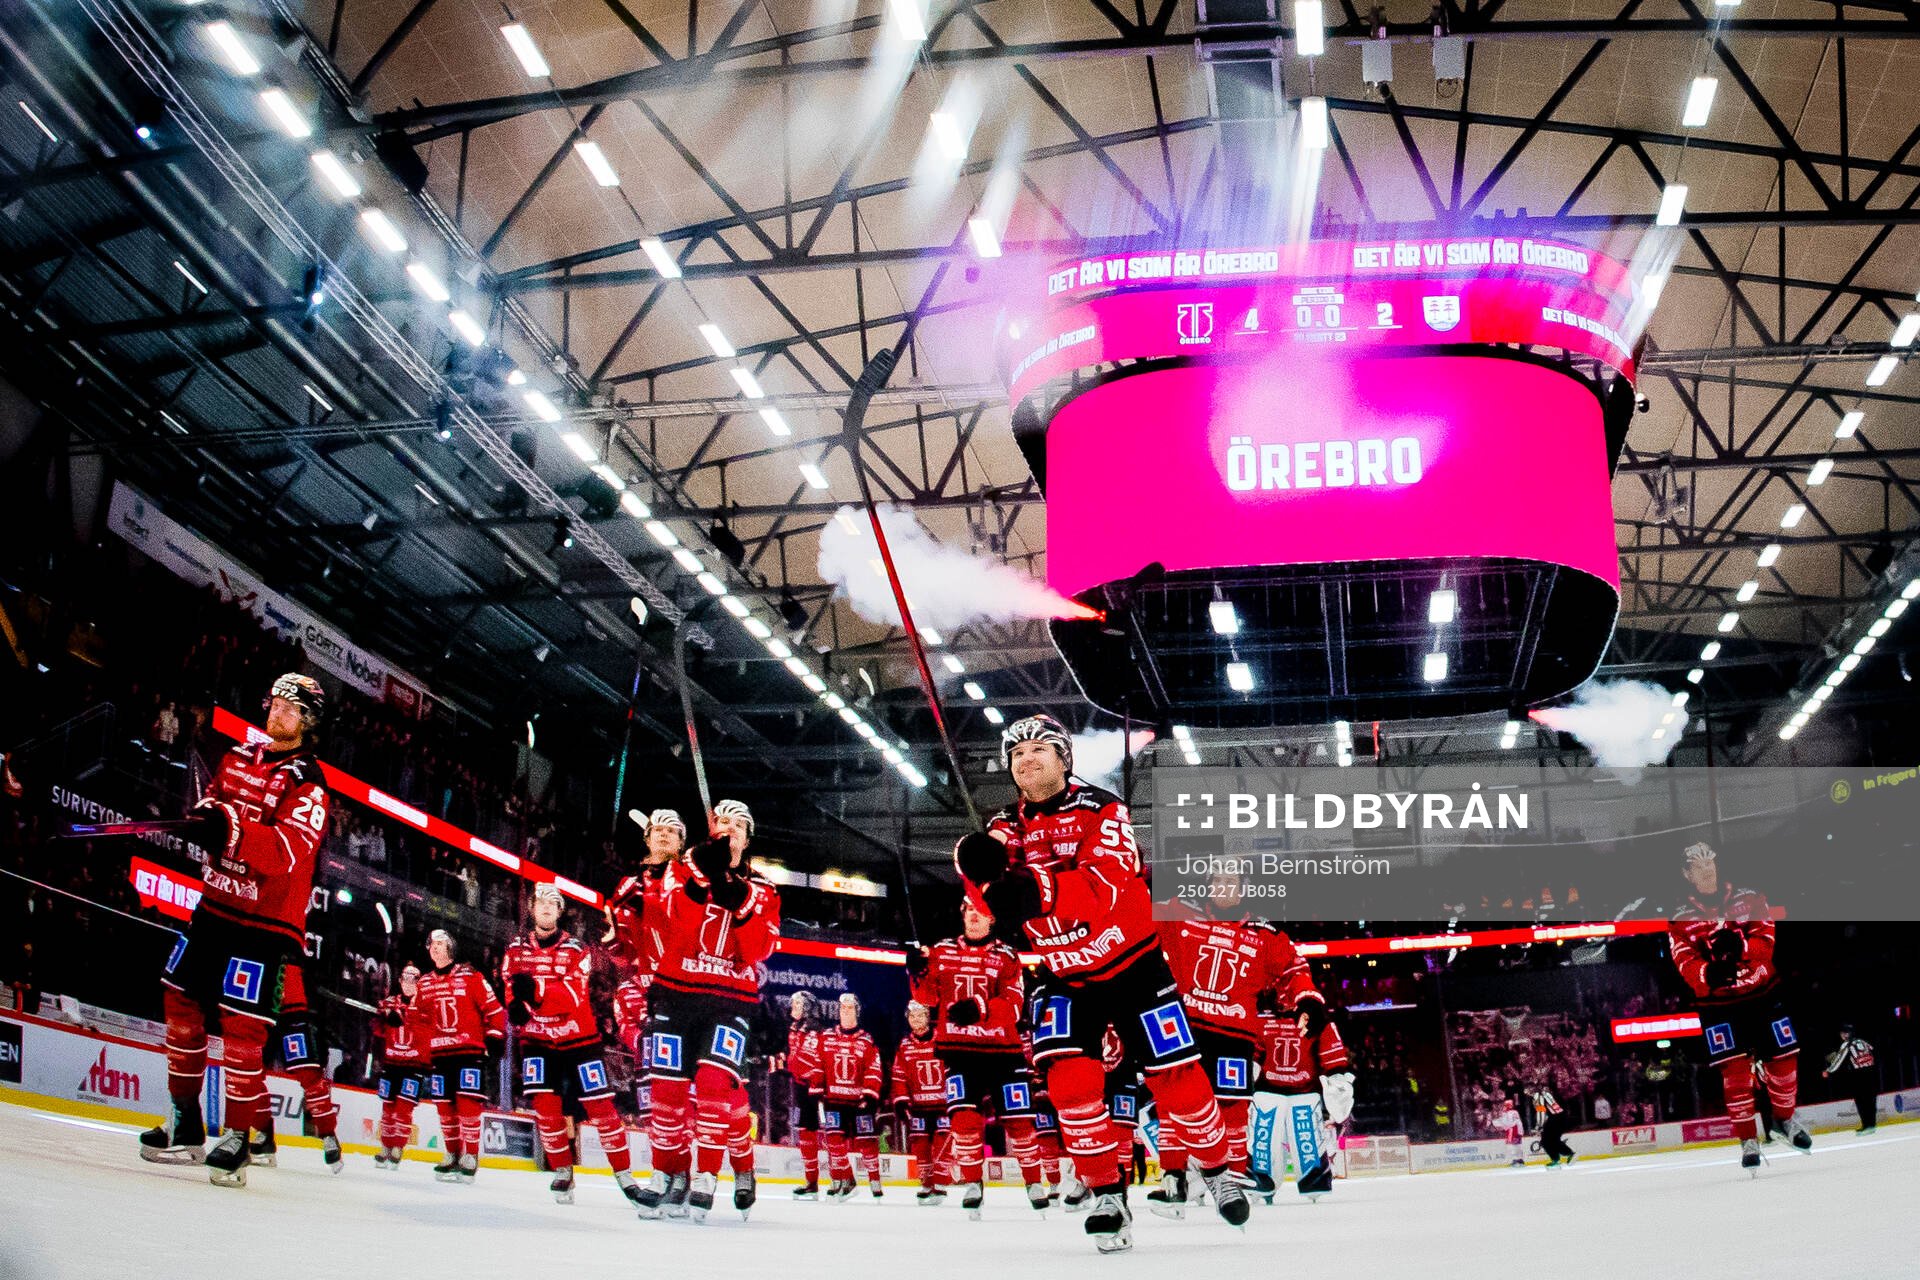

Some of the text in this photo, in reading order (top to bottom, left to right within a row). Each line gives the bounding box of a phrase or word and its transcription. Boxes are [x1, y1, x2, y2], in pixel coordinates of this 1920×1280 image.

[1048, 267, 1078, 296] DET
[1105, 258, 1125, 281] VI
[1127, 256, 1172, 279] SOM
[1203, 250, 1278, 275] ÖREBRO
[1353, 246, 1391, 268] DET
[1422, 243, 1444, 266] VI
[1446, 241, 1491, 266] SOM
[1521, 239, 1589, 275] ÖREBRO
[1244, 308, 1259, 331] 4
[1376, 302, 1393, 326] 2
[1227, 436, 1422, 491] ÖREBRO
[292, 796, 326, 832] 28
[1100, 819, 1137, 852] 55
[135, 868, 158, 897] DET
[1615, 1128, 1652, 1144] TAM
